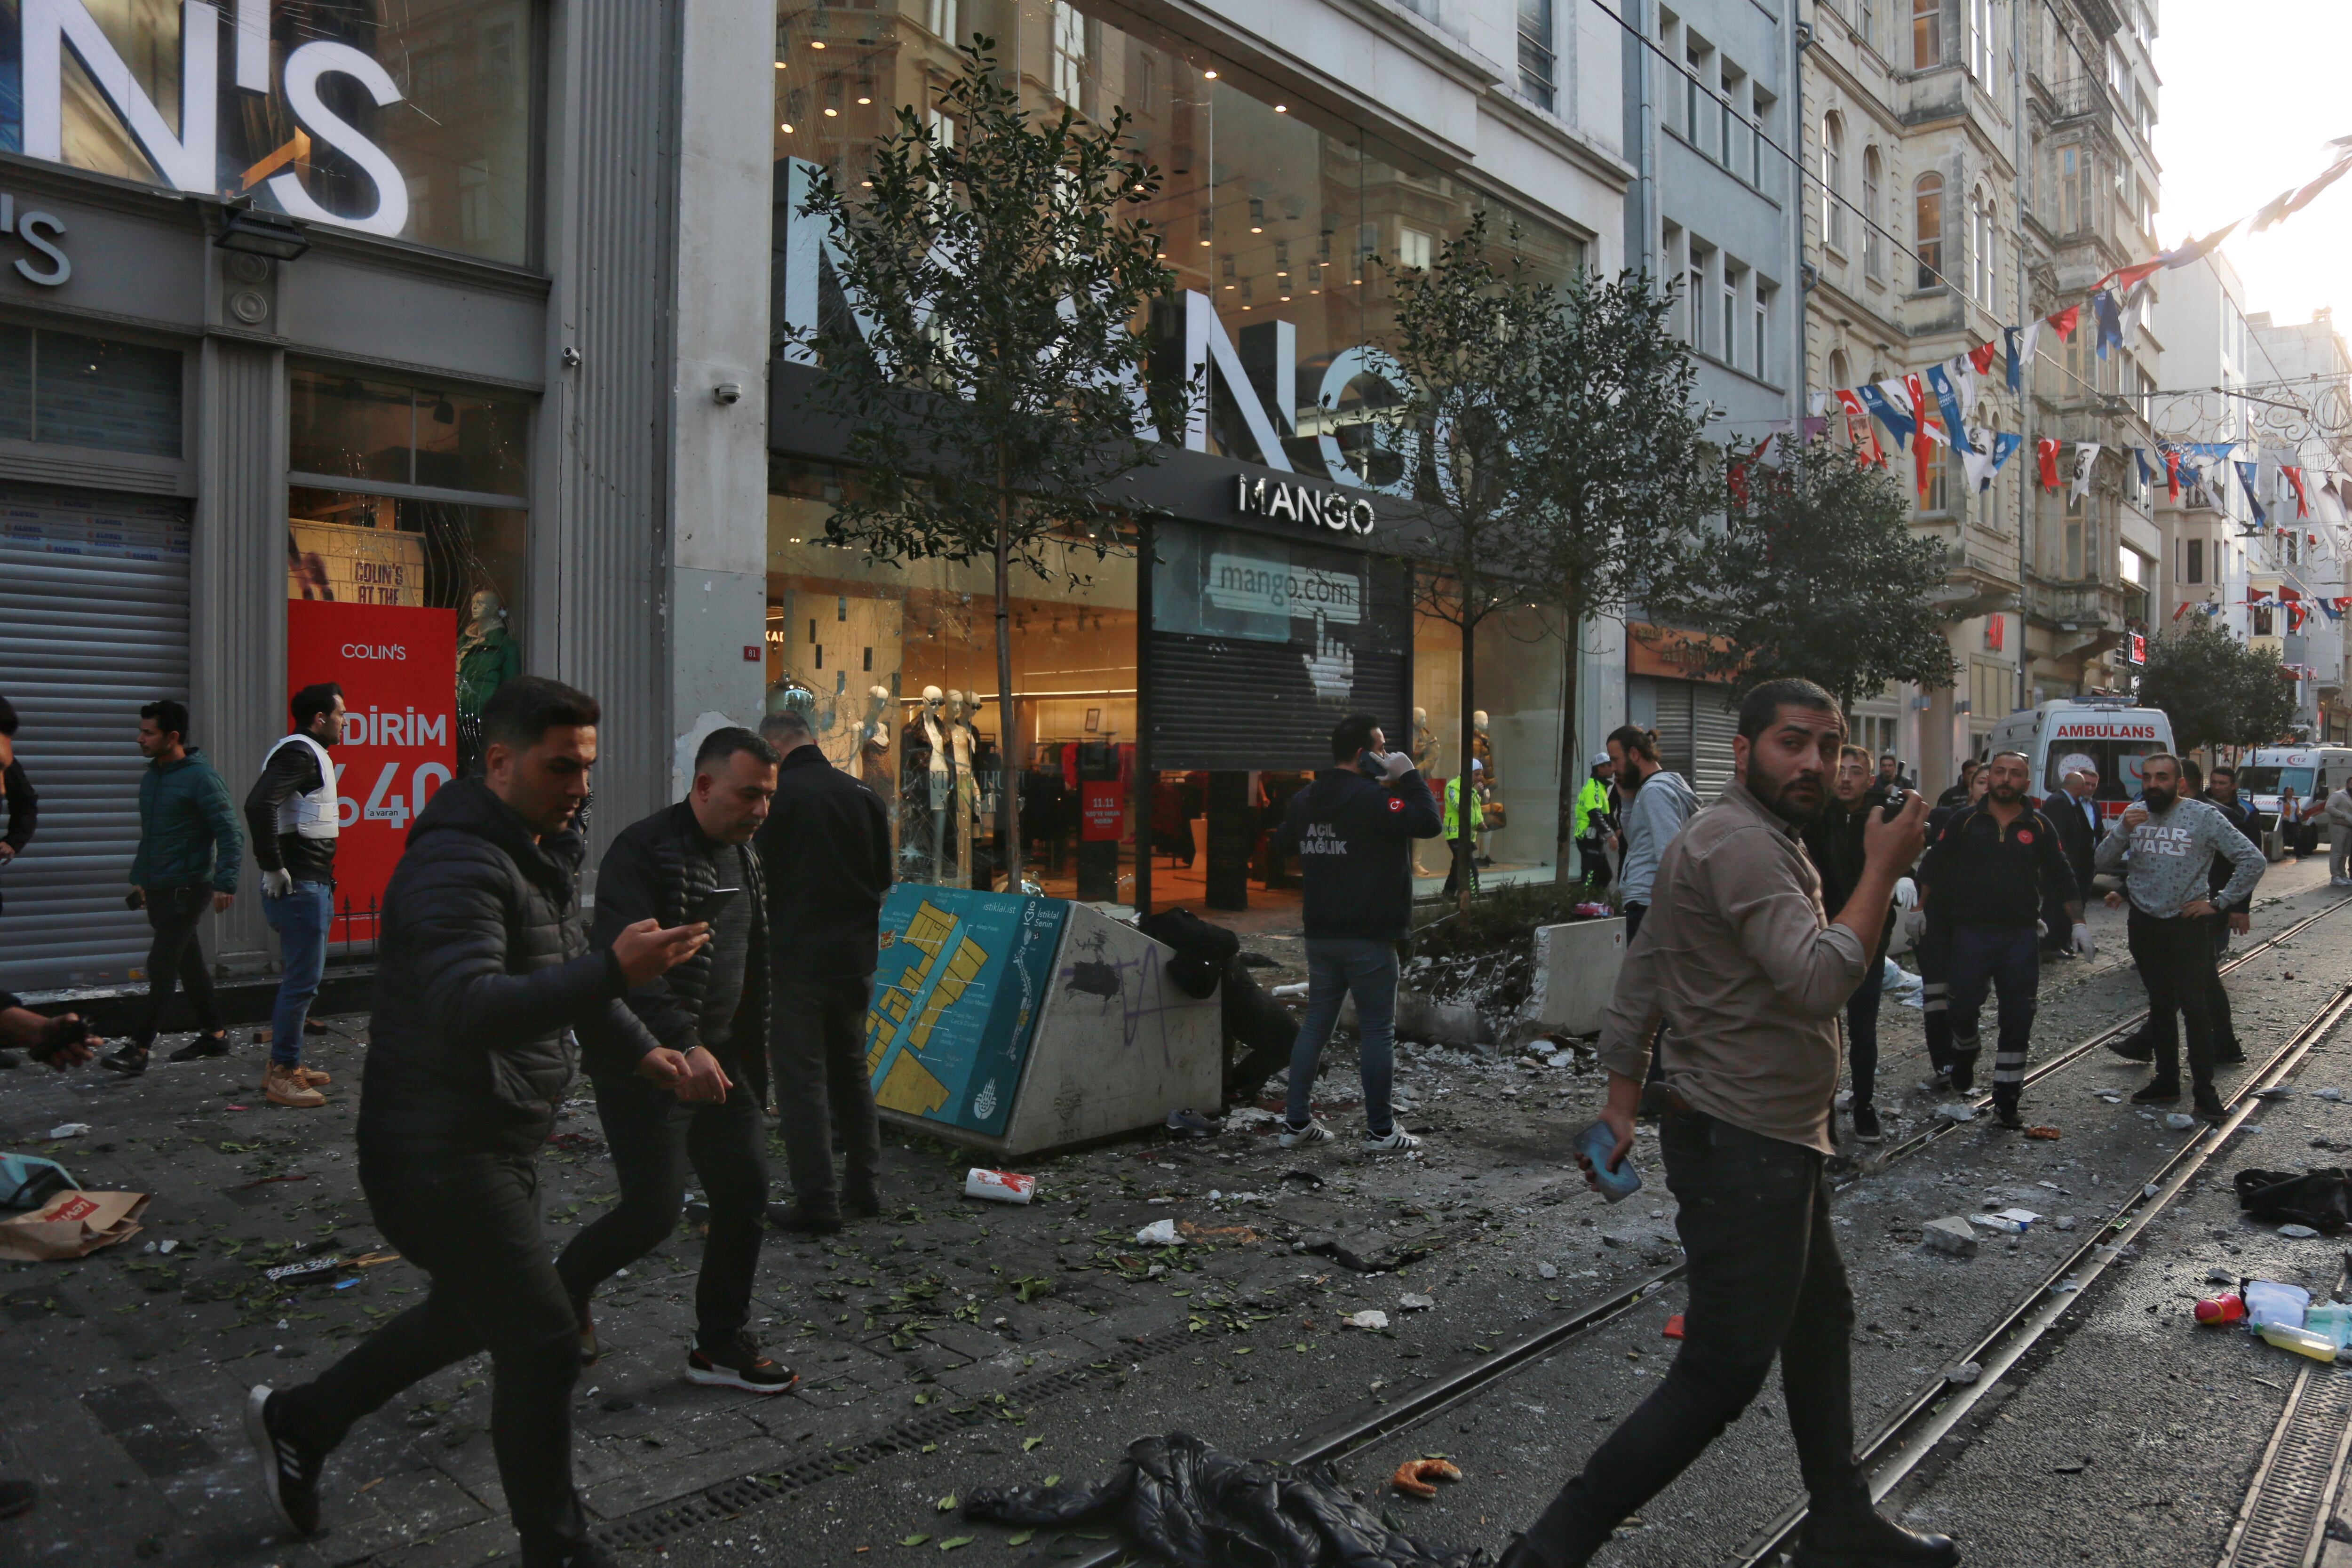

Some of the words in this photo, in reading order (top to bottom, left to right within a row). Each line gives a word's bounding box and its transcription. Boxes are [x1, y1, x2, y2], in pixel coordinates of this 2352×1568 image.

[1238, 474, 1375, 535] MANGO
[355, 562, 403, 585] COLIN'S
[1221, 565, 1351, 607] mango.com
[358, 586, 374, 604] AT
[378, 587, 399, 605] THE
[342, 644, 406, 660] COLIN'S
[338, 706, 446, 746] DİRİM
[2057, 725, 2155, 738] AMBULANS
[1093, 798, 1114, 807] 11.11
[2130, 826, 2192, 843] STAR
[1300, 837, 1347, 854] SAĞLIK
[2130, 839, 2192, 857] WARS
[983, 902, 1016, 914] istiklal.ist
[1037, 907, 1059, 920] İstiklal
[1034, 918, 1052, 928] Senin
